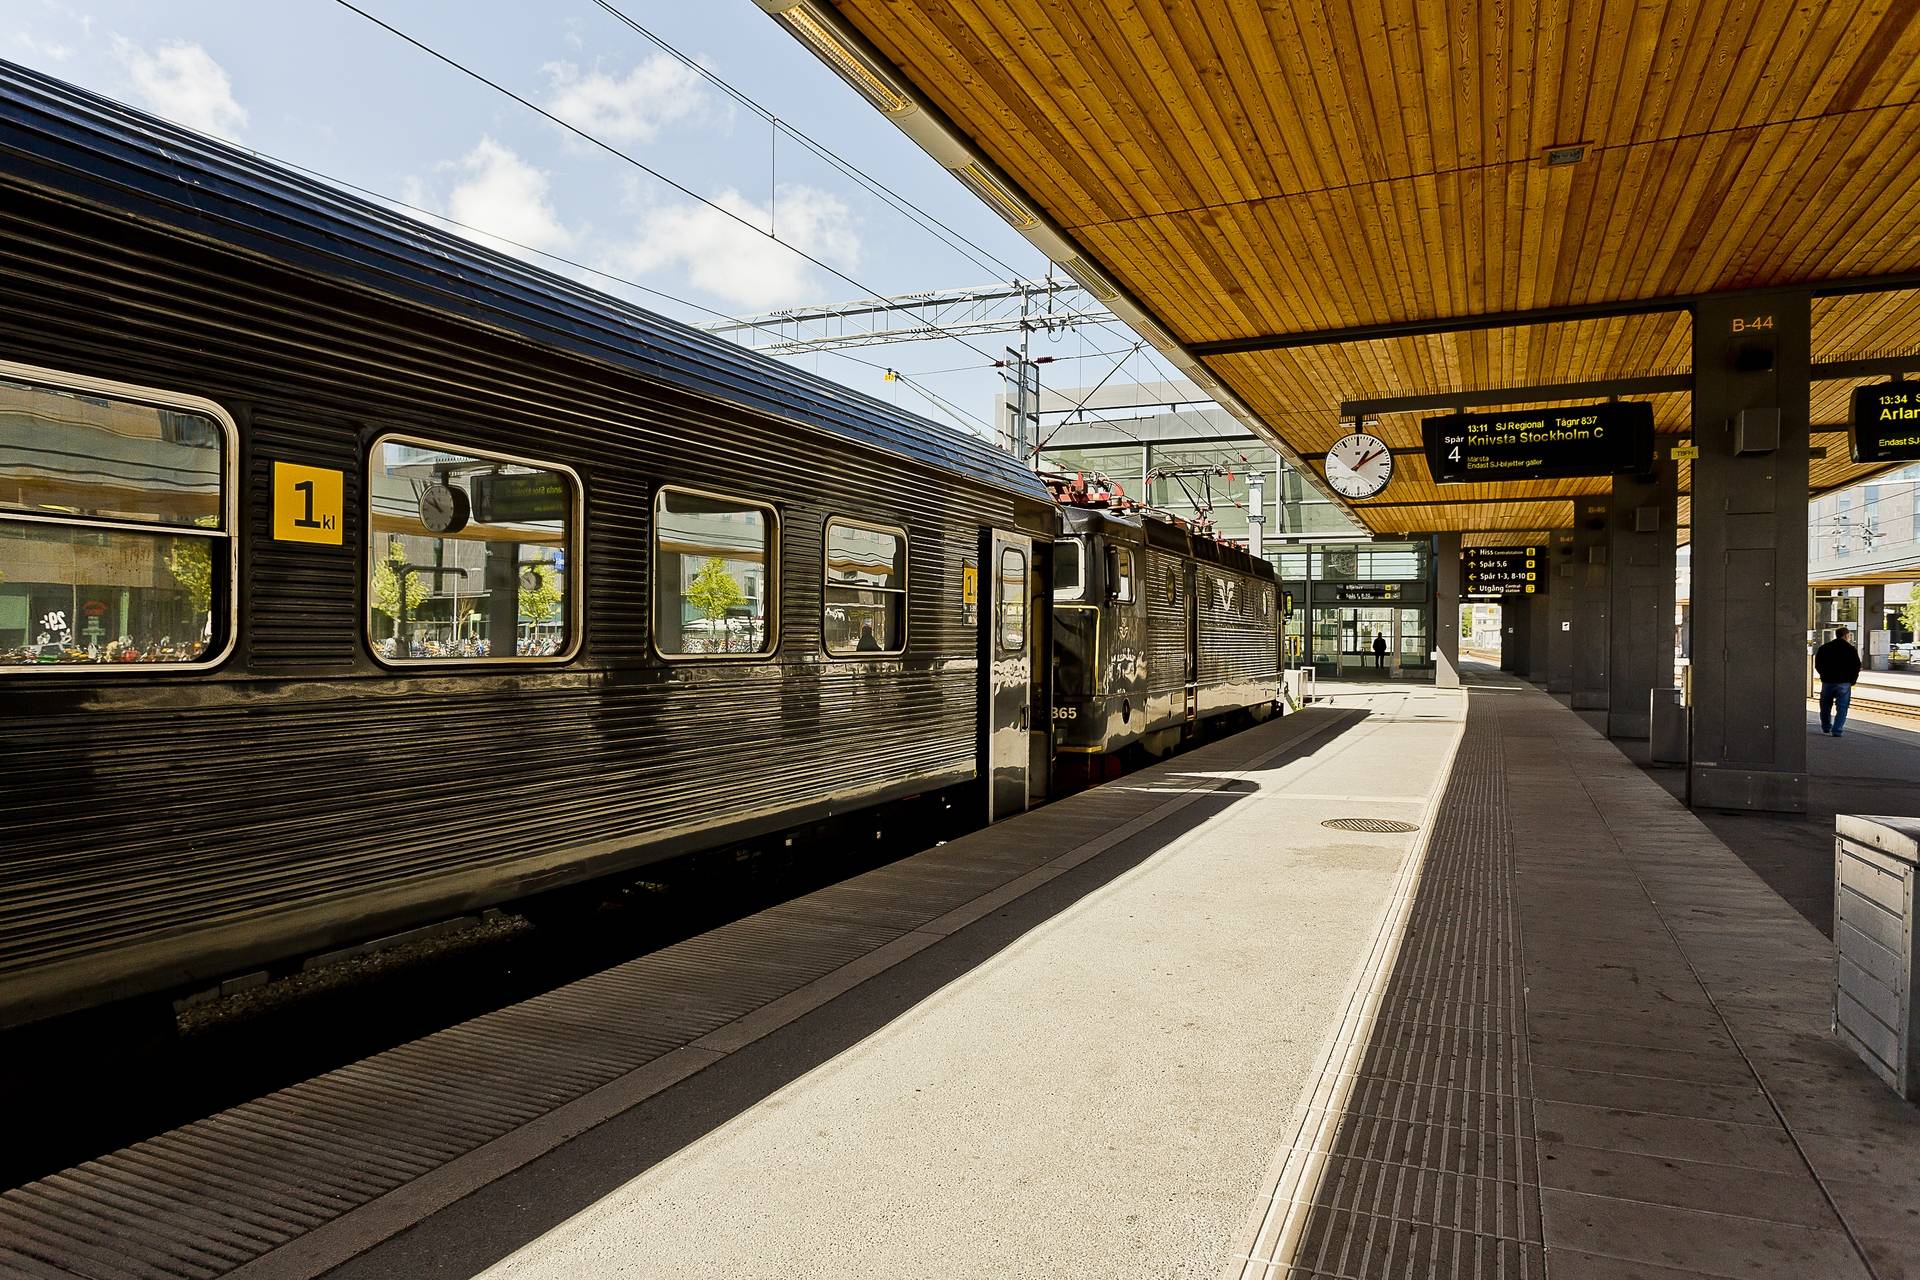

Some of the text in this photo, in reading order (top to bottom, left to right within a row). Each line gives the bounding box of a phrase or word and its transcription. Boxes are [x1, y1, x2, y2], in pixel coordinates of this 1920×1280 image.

[1732, 315, 1774, 332] B-44
[1879, 394, 1908, 405] 13:34
[1467, 423, 1488, 433] 13:11
[1495, 422, 1507, 431] SJ
[1508, 420, 1545, 431] Regional
[1581, 416, 1598, 426] 837
[1444, 435, 1464, 444] Spår
[1468, 427, 1604, 446] Knivsta Stockholm C
[1878, 438, 1907, 447] Endast
[1448, 445, 1461, 463] 4
[1467, 461, 1489, 470] Endast
[294, 480, 336, 530] 1 kl
[1479, 560, 1495, 569] Spår
[1480, 572, 1496, 580] Spår
[1511, 572, 1526, 580] 8-10
[967, 575, 973, 597] 1
[1479, 585, 1504, 593] Utgång
